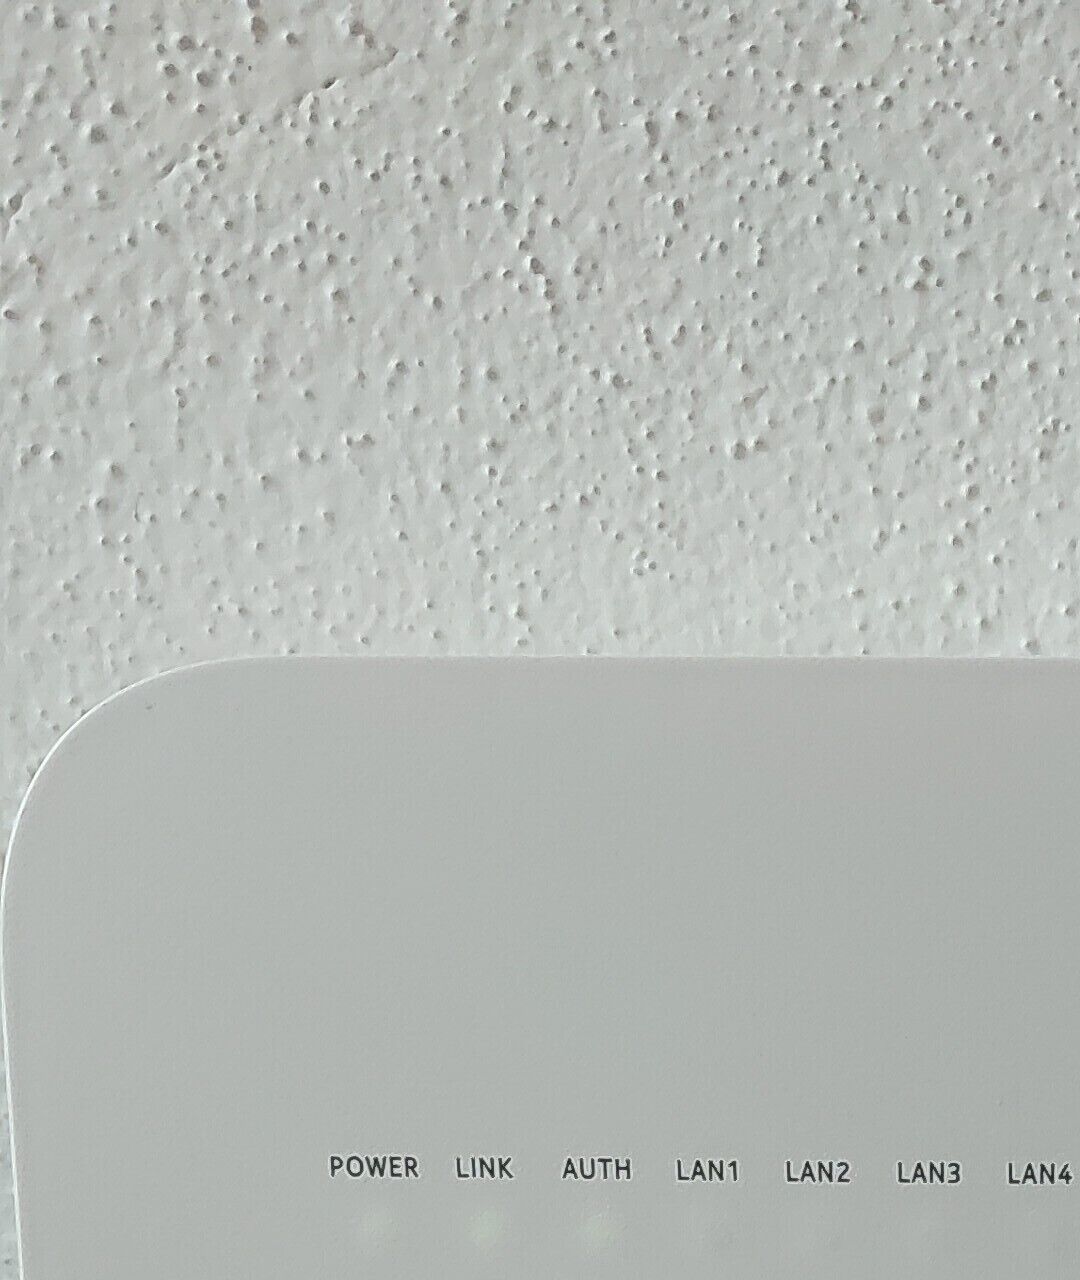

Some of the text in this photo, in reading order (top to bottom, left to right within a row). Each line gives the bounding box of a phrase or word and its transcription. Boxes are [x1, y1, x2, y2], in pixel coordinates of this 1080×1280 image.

[330, 1156, 420, 1179] POWER
[455, 1156, 514, 1180] LINK
[561, 1157, 631, 1181] AUTH
[676, 1159, 740, 1183] LAN1
[785, 1160, 851, 1184] LAN2
[897, 1161, 961, 1184] LAN3
[1007, 1162, 1073, 1186] LAN4
